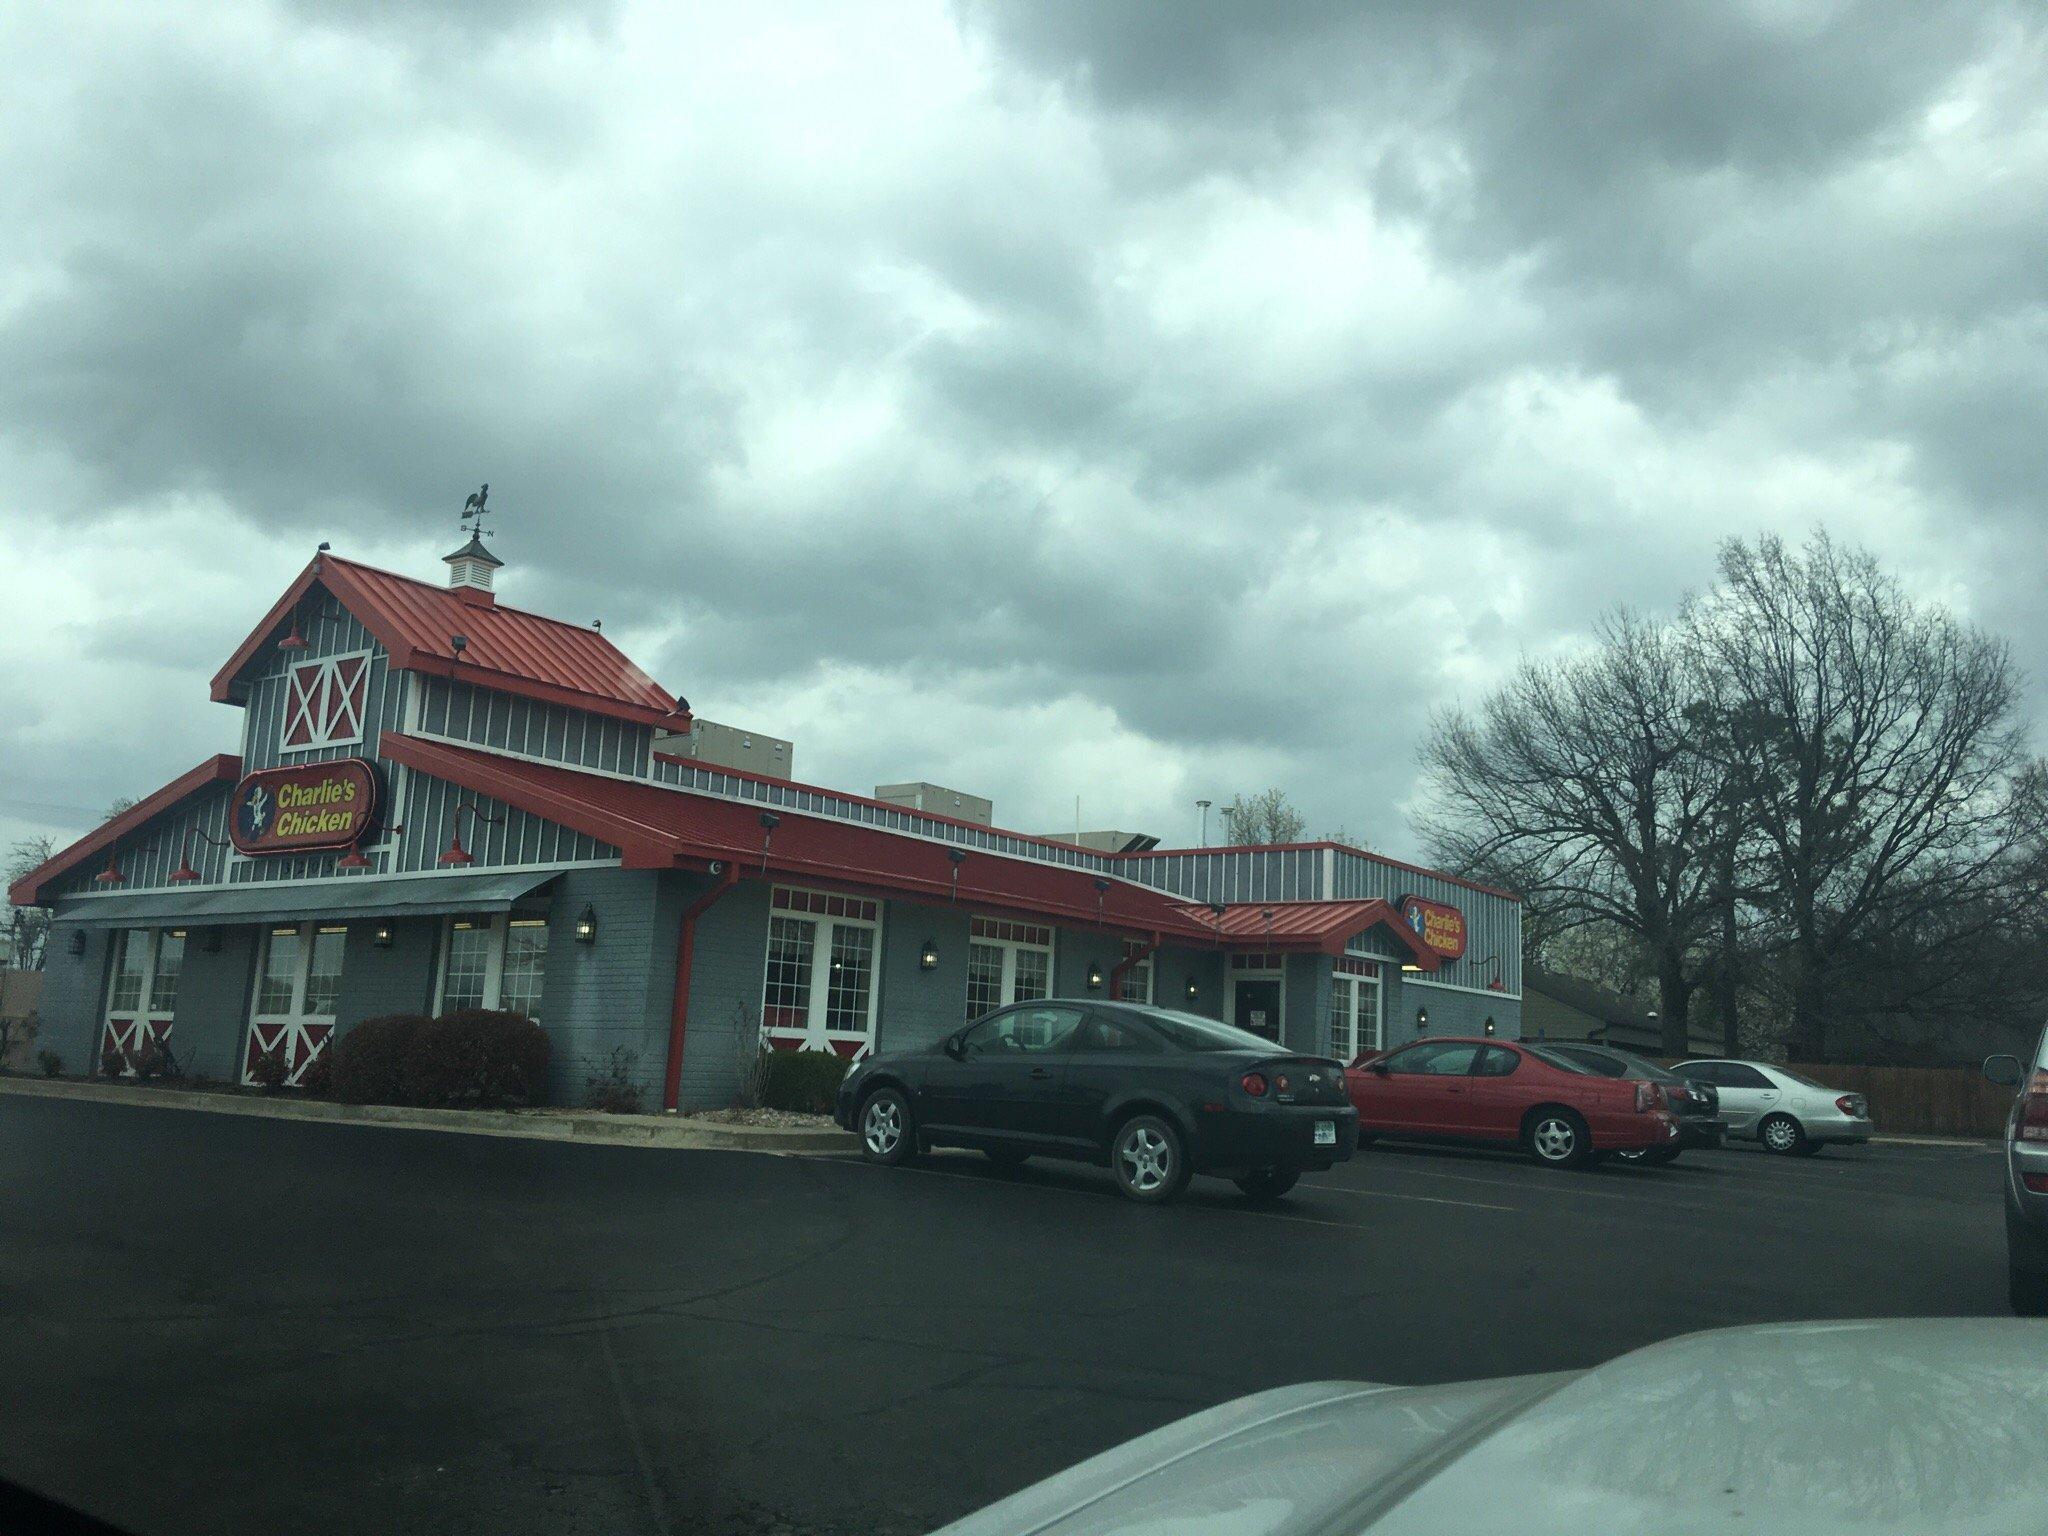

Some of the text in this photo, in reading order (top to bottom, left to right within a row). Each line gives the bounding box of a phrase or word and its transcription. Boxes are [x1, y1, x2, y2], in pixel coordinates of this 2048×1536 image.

[278, 778, 356, 809] Charlie's
[276, 809, 353, 837] Chicken
[283, 859, 334, 875] 3205
[1424, 909, 1461, 933] Charlie's
[1424, 927, 1459, 951] Chicken
